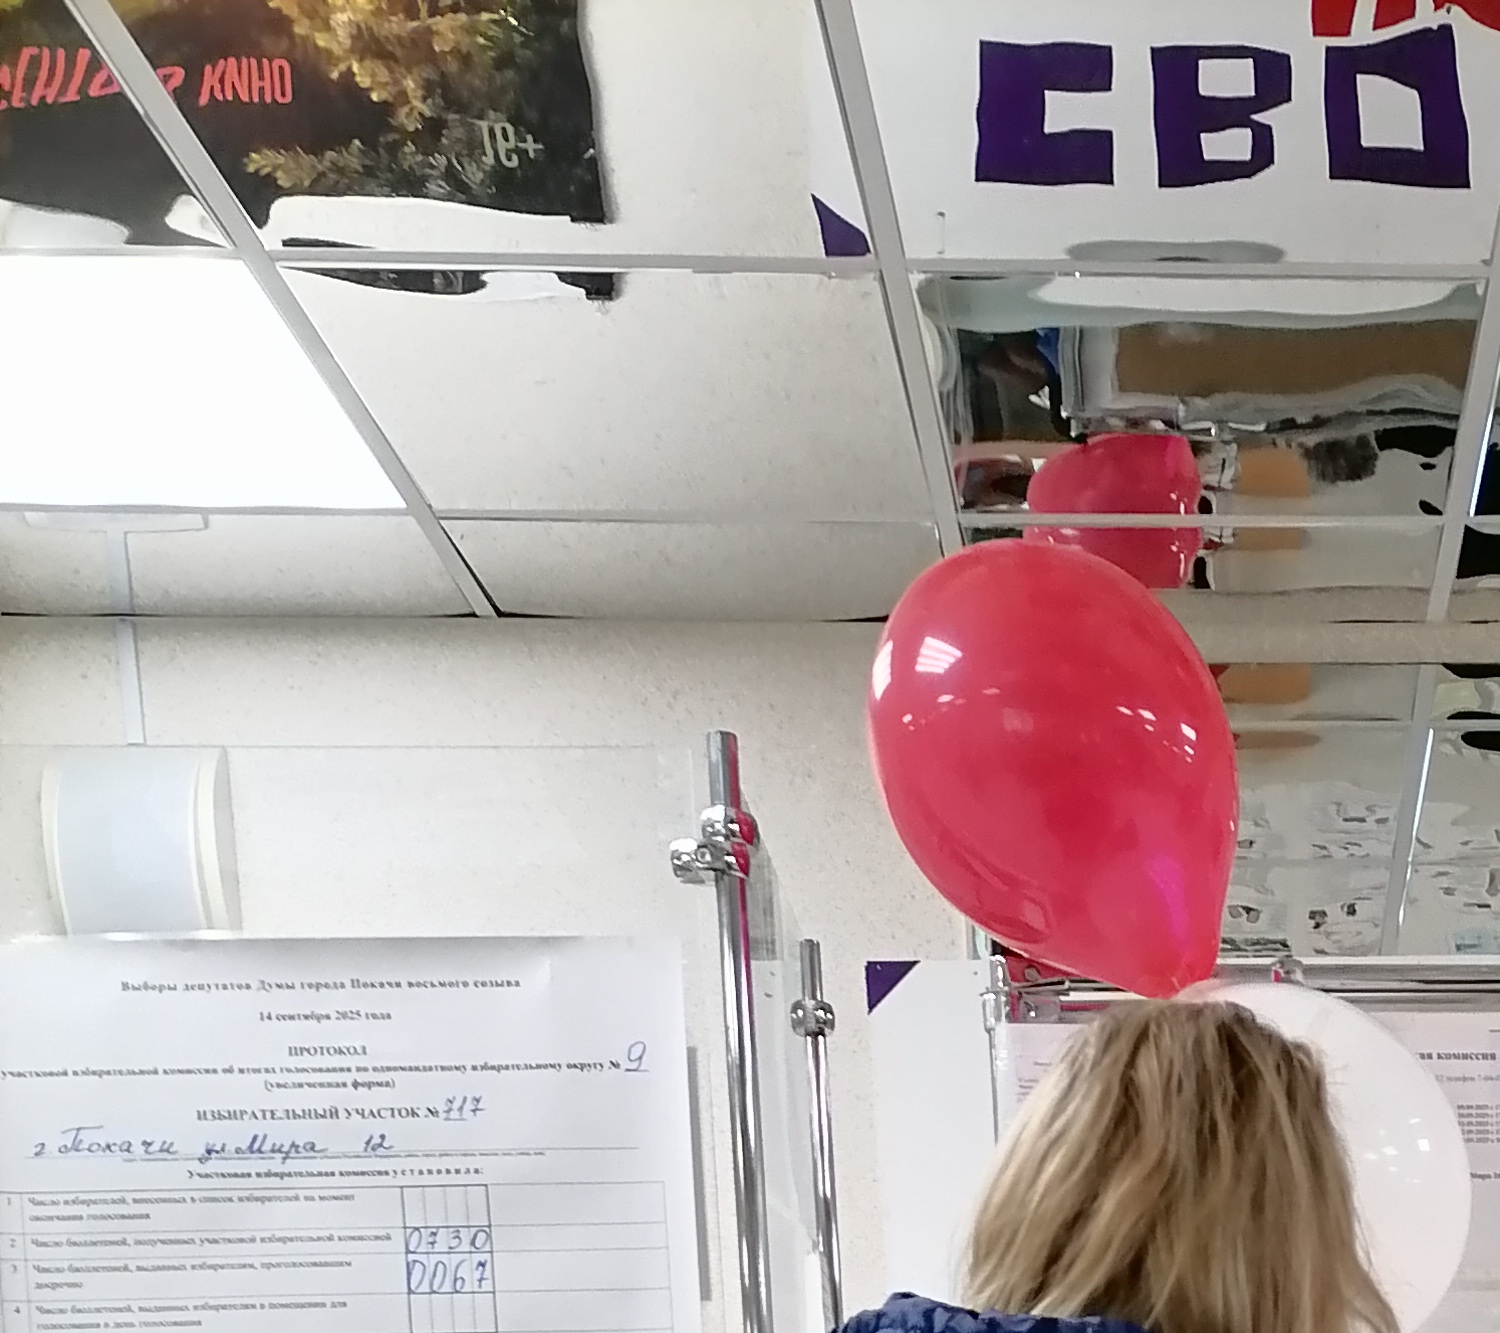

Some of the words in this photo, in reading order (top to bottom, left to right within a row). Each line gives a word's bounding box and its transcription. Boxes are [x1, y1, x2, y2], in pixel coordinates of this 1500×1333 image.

[288, 1045, 367, 1056] ПРОТОКОЛ
[196, 1105, 339, 1121] ИЗБИРАТЕЛЬНЫЙ
[344, 1106, 421, 1120] УЧАСТОК
